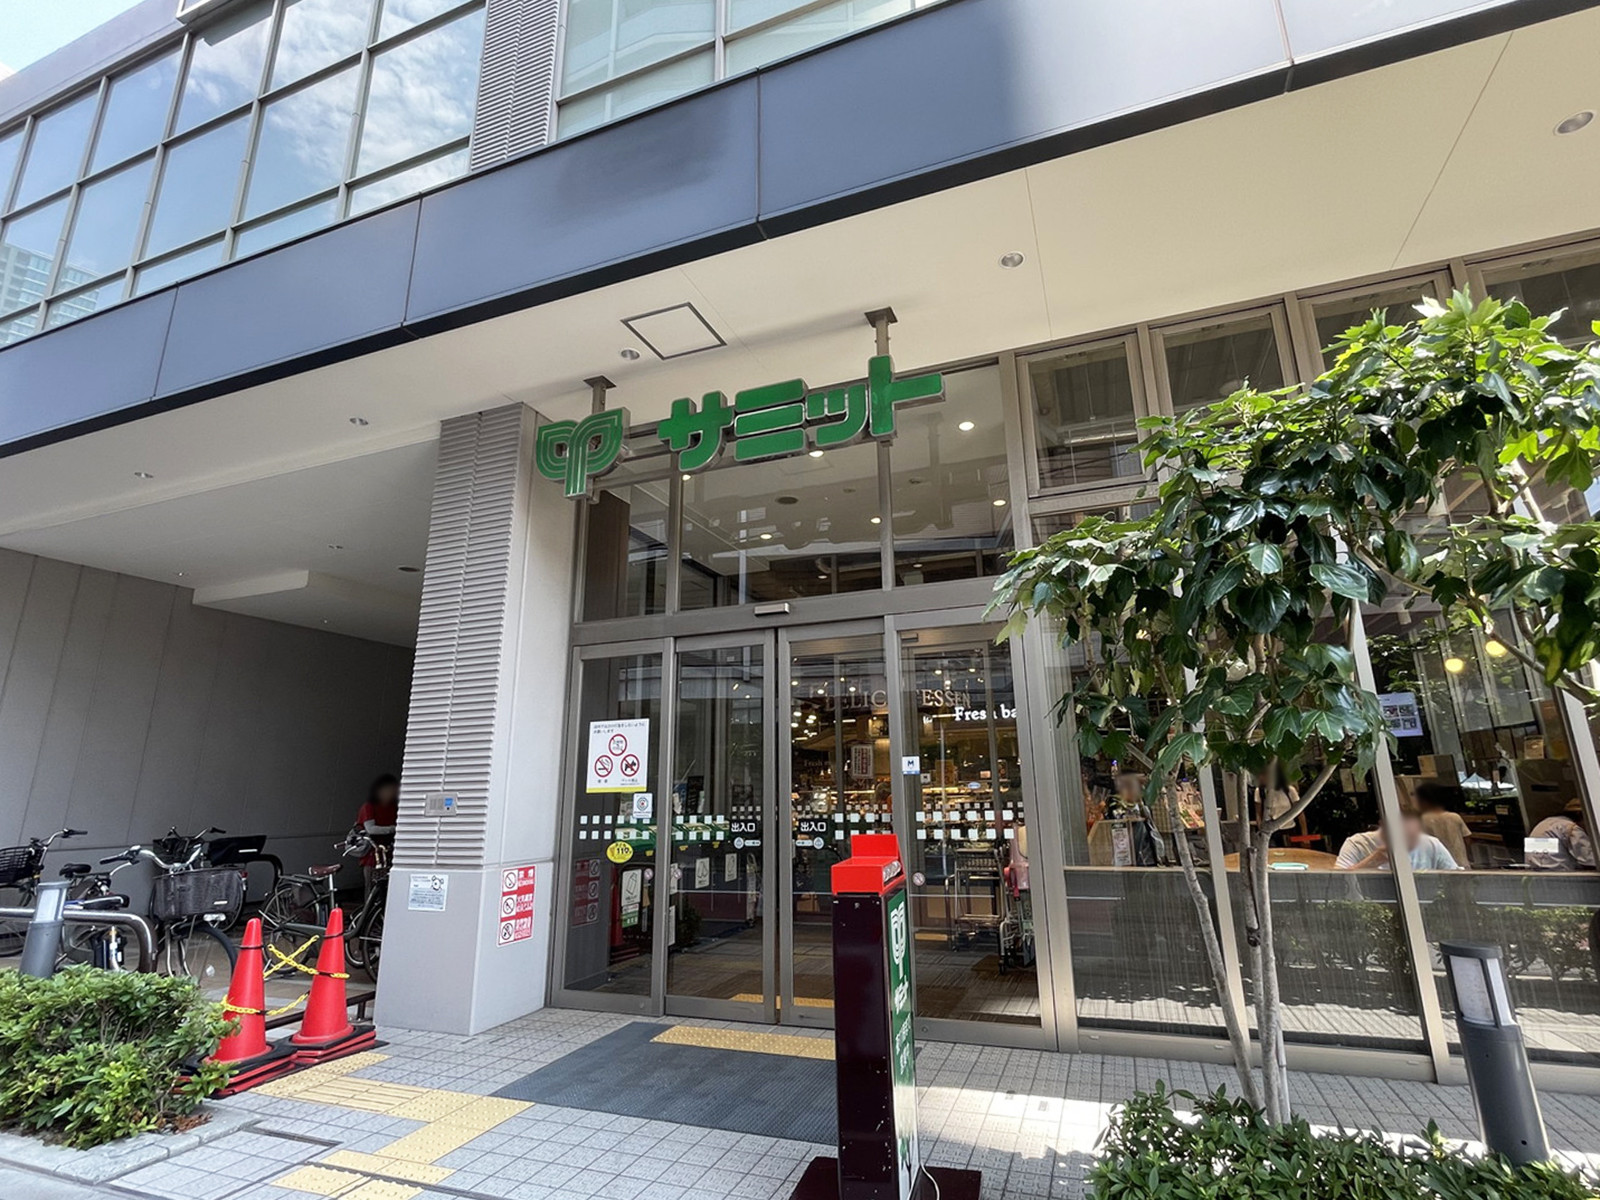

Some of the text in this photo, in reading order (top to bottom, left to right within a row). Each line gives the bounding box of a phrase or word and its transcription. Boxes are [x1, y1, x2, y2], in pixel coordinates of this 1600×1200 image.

[657, 355, 946, 473] サミット
[731, 822, 756, 832] 出入口
[800, 821, 827, 832] 出入口
